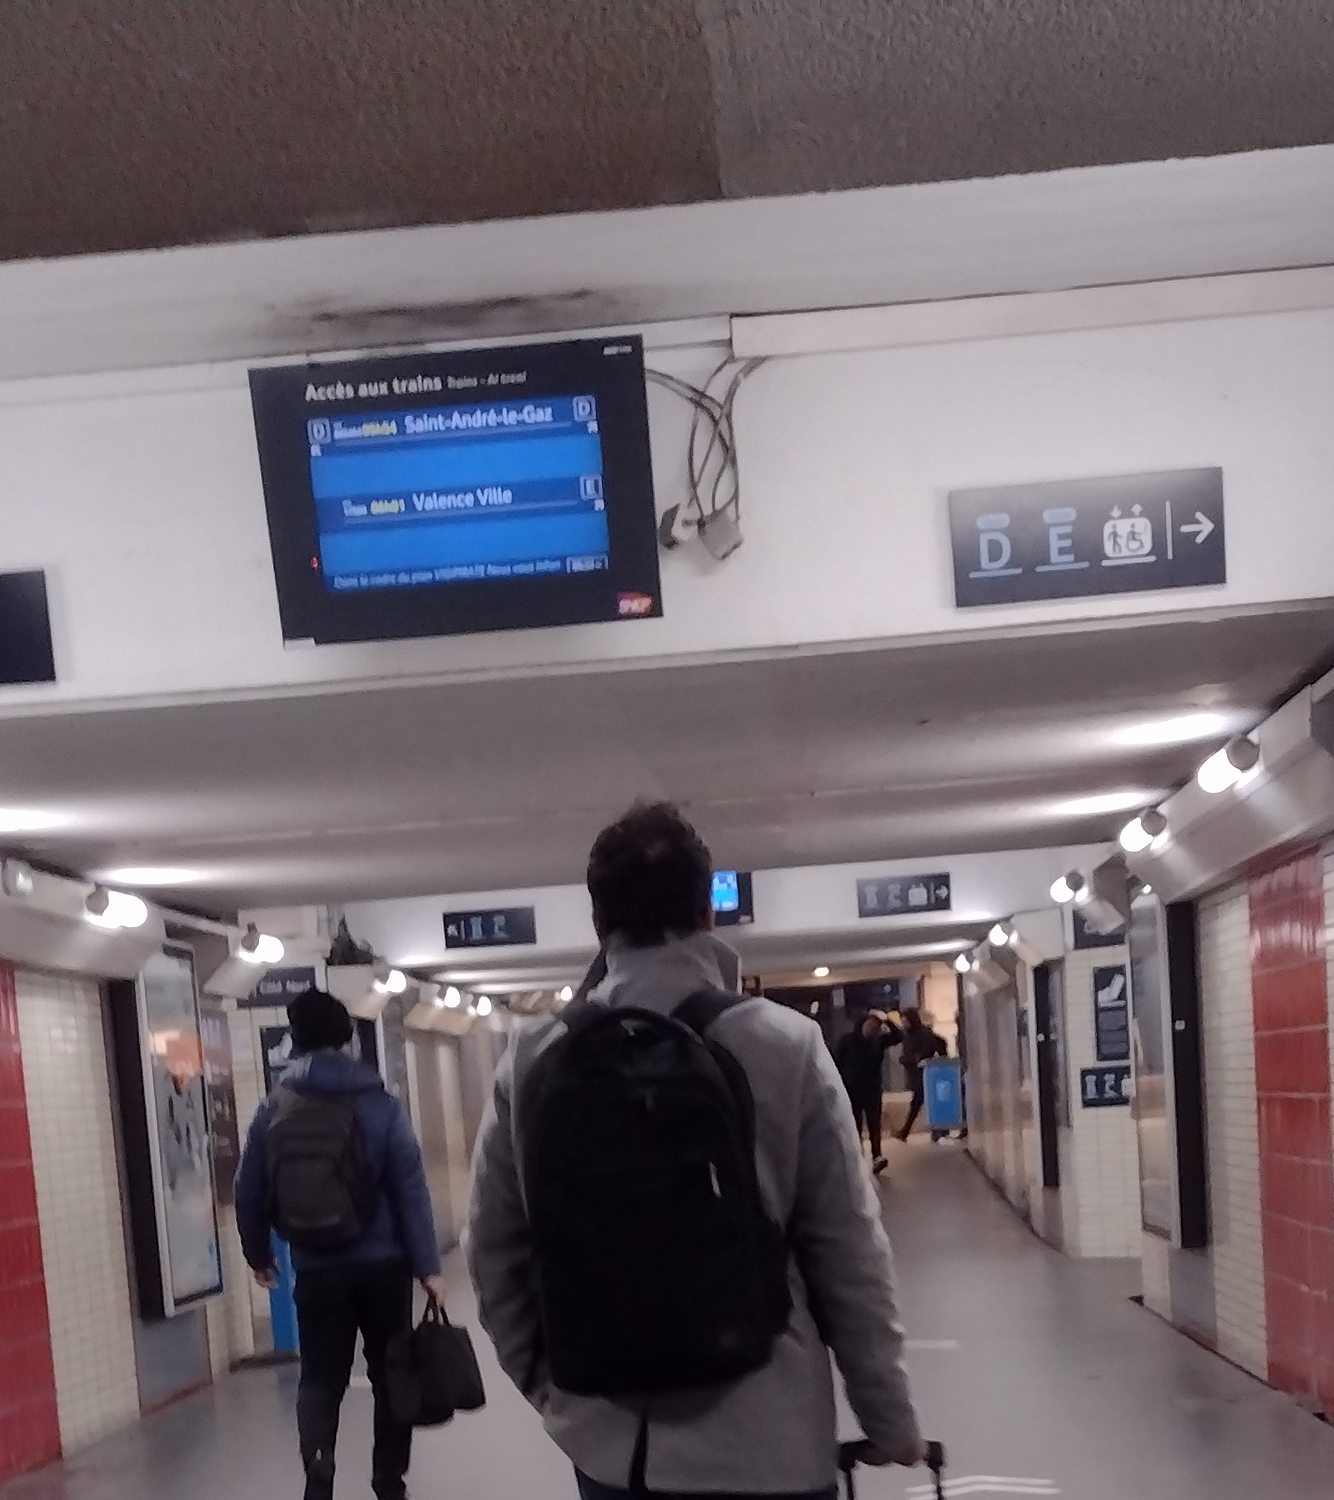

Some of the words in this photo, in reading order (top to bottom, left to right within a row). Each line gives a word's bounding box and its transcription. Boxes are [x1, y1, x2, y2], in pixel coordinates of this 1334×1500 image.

[392, 374, 443, 395] trains
[477, 486, 513, 507] Ville
[978, 531, 1012, 570] D
[1048, 525, 1075, 564] E
